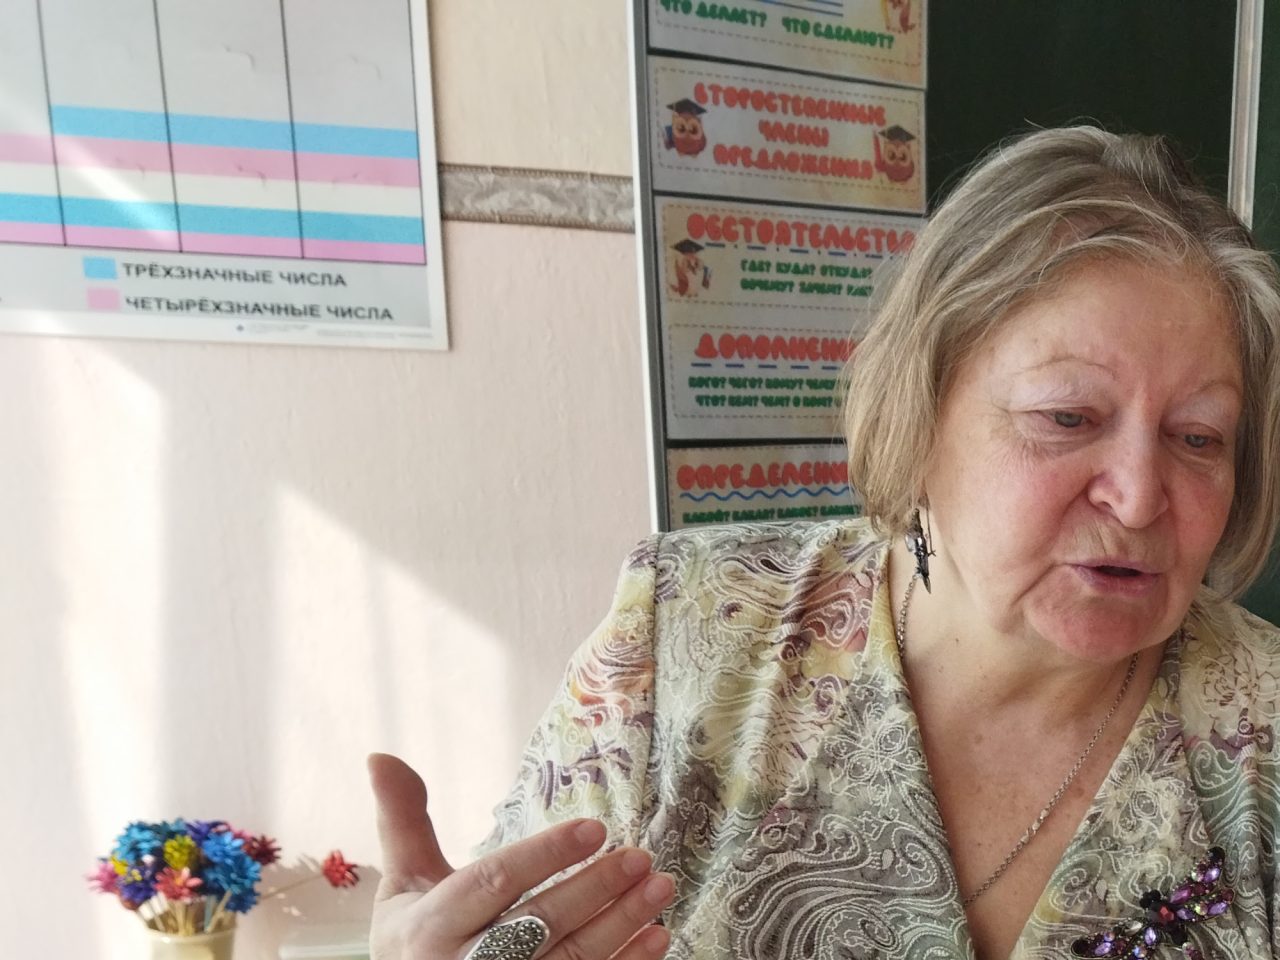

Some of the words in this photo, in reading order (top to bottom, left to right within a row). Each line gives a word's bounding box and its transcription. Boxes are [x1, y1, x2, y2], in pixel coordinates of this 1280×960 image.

[781, 16, 810, 36] ЧТО
[759, 119, 830, 147] ЧЛЕНЫ
[713, 143, 873, 180] ПРЕДЛОЖЕНИЯ
[122, 262, 273, 284] ТРЁХЗНАЧНЫЕ
[279, 272, 347, 287] ЧИСЛА
[125, 296, 321, 319] ЧЕТЫРЁХЗНАЧНЫЕ
[326, 306, 393, 321] ЧИСЛА
[695, 333, 856, 362] ДОПОЛНЕНИ
[677, 461, 848, 490] ОПРЕДЕЛЕНИ
